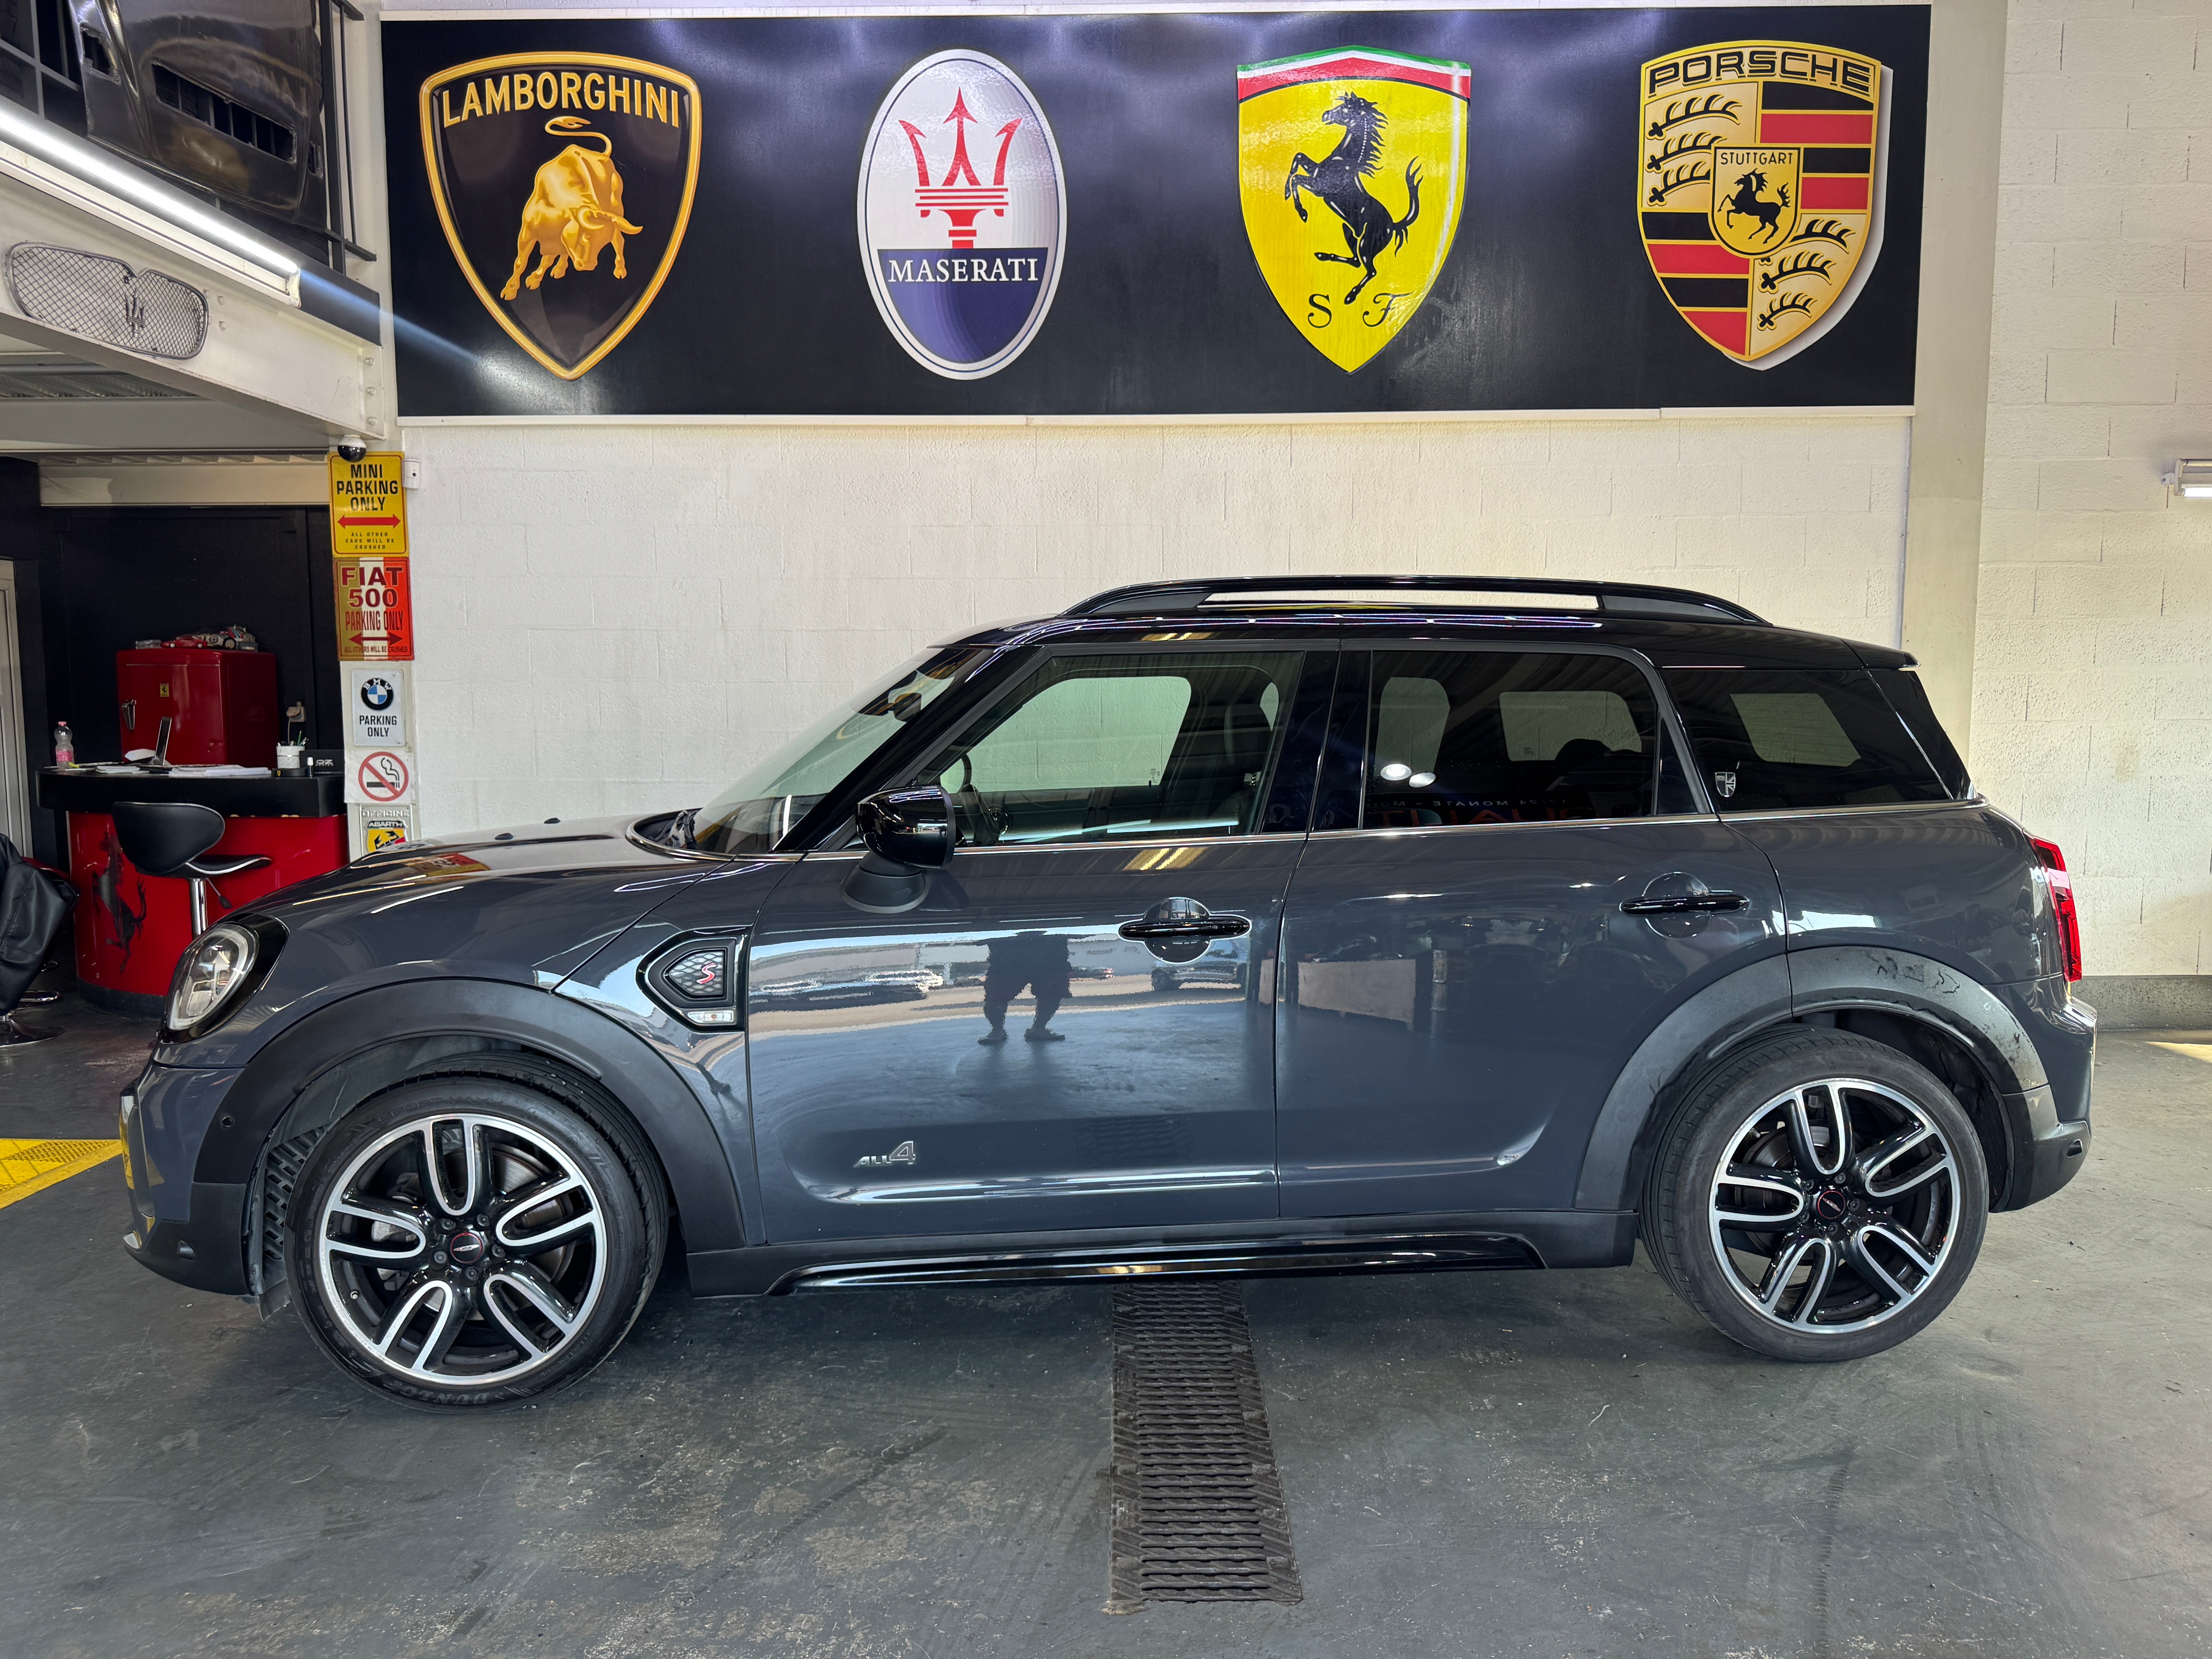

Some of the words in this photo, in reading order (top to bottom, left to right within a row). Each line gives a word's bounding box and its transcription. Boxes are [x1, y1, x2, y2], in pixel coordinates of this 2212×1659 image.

[1648, 50, 1872, 99] PORSCHE
[442, 72, 679, 129] LAMBORGHINI
[1720, 151, 1793, 165] STUTTGART
[888, 258, 1039, 283] MASERATI
[1307, 294, 1332, 328] S
[351, 464, 383, 478] MINI
[337, 480, 398, 495] PARKING
[350, 497, 385, 511] ONLY
[341, 567, 403, 586] FIAT
[348, 588, 397, 608] 500
[345, 610, 381, 631] PARKING
[383, 610, 404, 631] ONLY
[363, 678, 392, 690] BMW
[359, 715, 397, 725] PARKING
[368, 727, 390, 737] ONLY
[696, 962, 717, 984] S
[853, 1140, 916, 1168] ALL4
